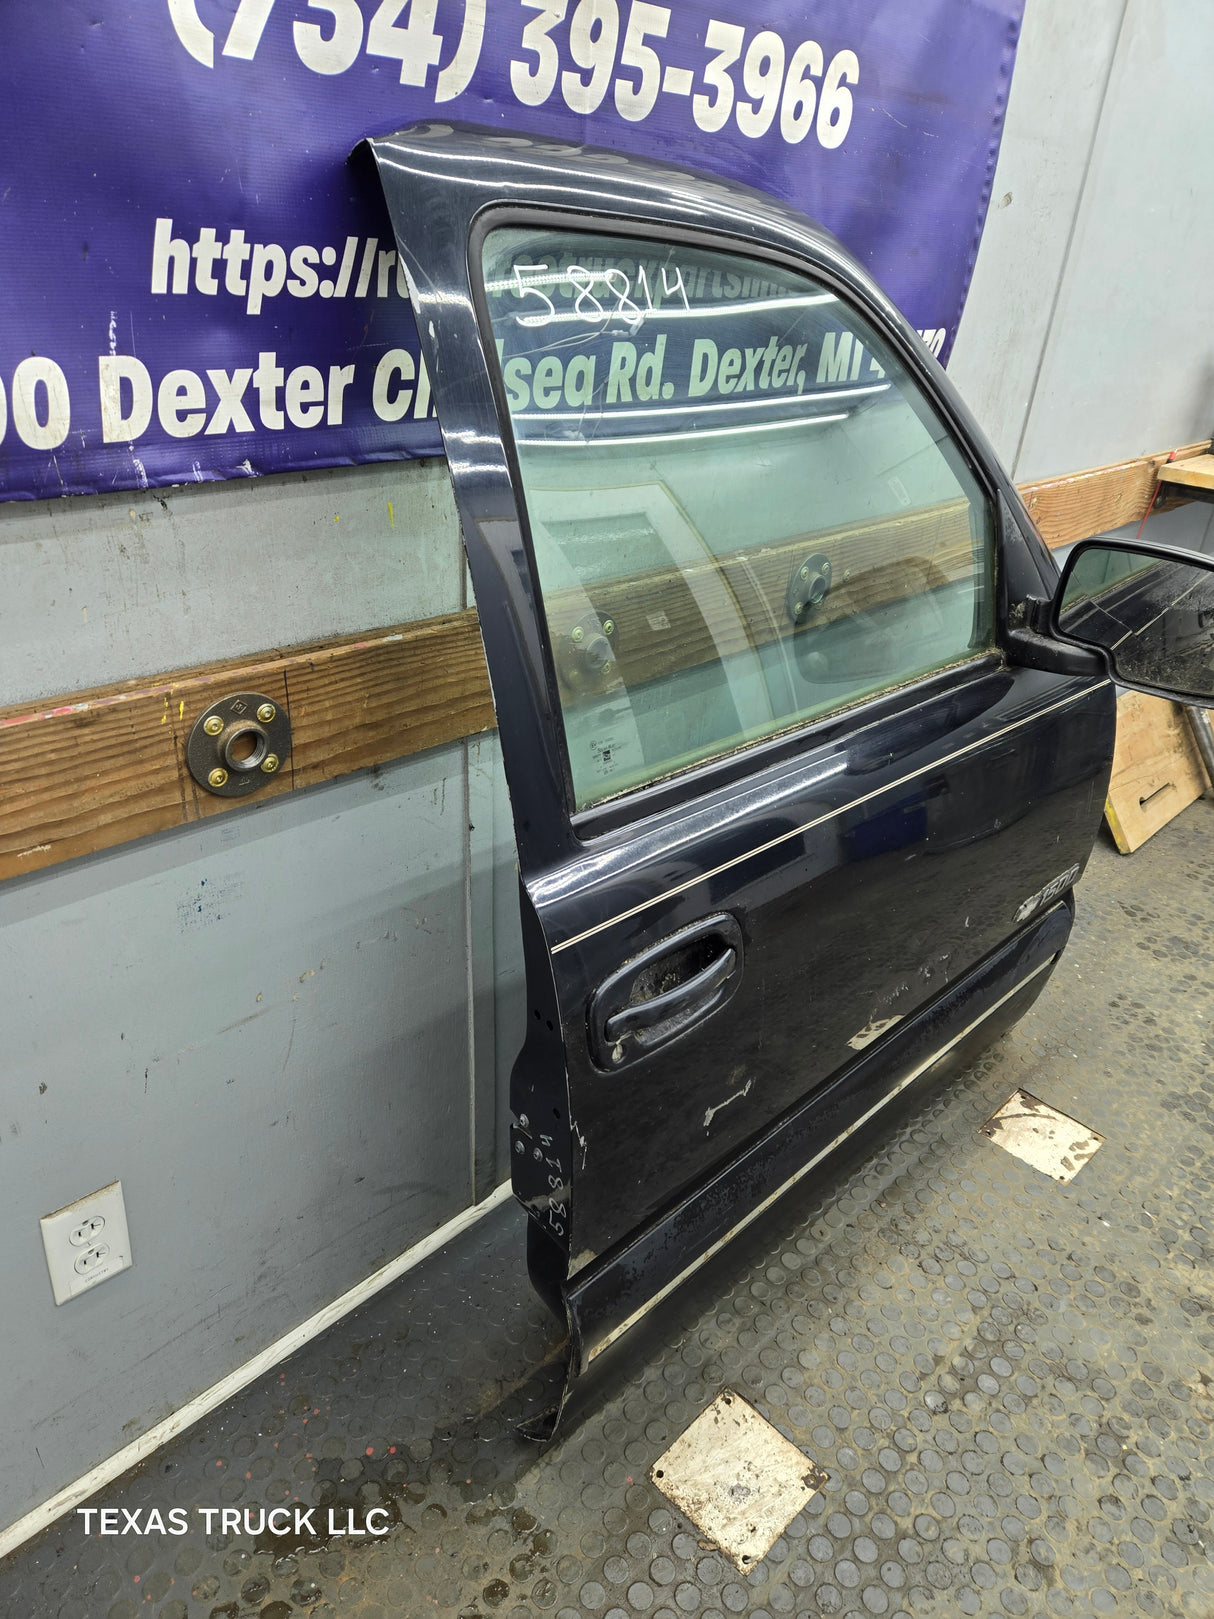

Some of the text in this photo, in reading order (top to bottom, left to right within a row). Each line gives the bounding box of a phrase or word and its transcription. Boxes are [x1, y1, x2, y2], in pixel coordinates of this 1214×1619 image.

[510, 0, 860, 149] 395-3966
[512, 264, 690, 327] 58814
[0, 356, 71, 450] 0
[98, 352, 353, 444] Dexter
[606, 334, 674, 404] Rd.
[688, 335, 807, 395] Dexter,
[815, 331, 864, 383] MI
[539, 1134, 567, 1237] 58814
